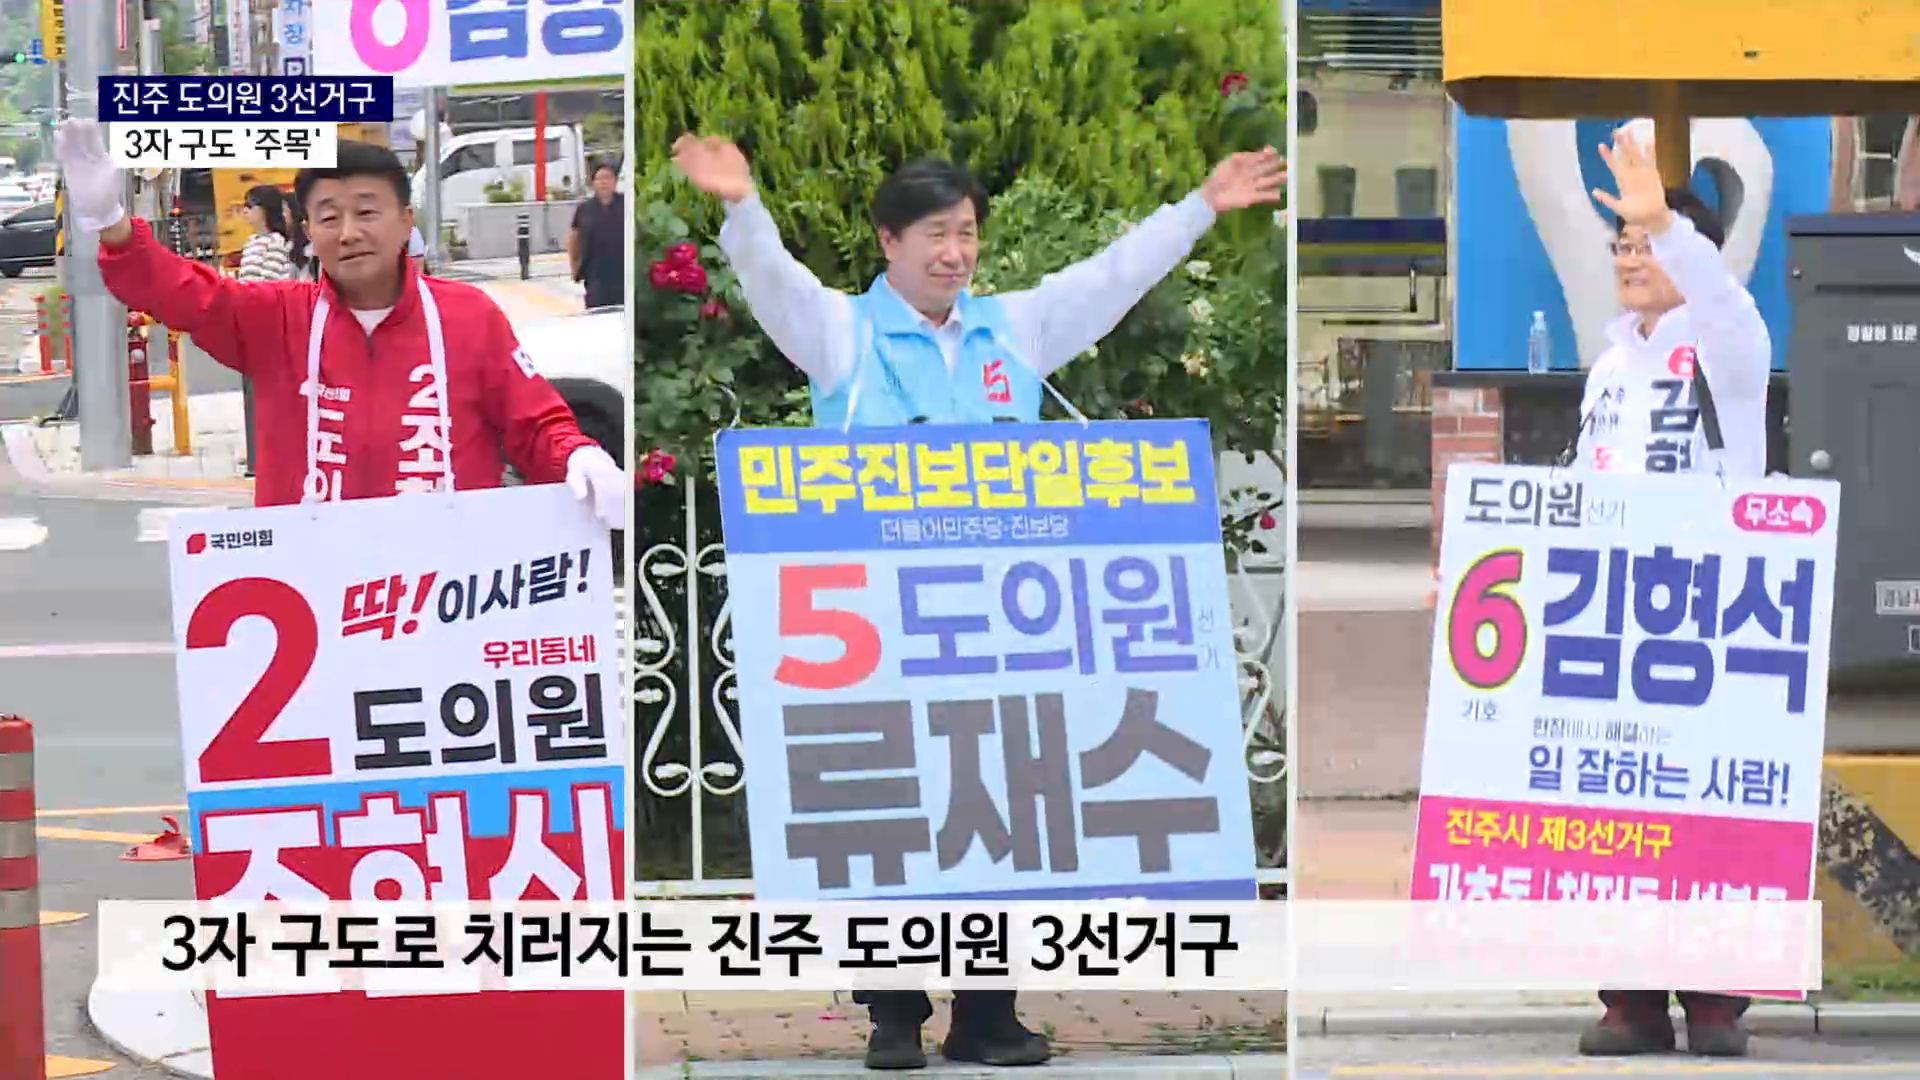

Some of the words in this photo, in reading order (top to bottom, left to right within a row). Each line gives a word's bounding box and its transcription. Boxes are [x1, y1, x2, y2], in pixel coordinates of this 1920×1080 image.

[738, 439, 1195, 515] 민주진보단일후보
[1464, 477, 1583, 528] 도의원
[210, 529, 273, 550] 국민의힘
[341, 571, 439, 641] 딱!
[437, 548, 591, 624] 이사람!
[774, 564, 882, 690] 5
[897, 555, 1198, 676] 도의원
[1448, 545, 1528, 690] 6
[1542, 545, 1815, 715] 김형석
[186, 576, 333, 783] 2
[483, 635, 596, 669] 우리동네
[354, 673, 608, 770] 도의원
[782, 687, 1221, 889] 류재수
[1529, 745, 1563, 792] 일
[1577, 748, 1690, 800] 잘하는
[1701, 756, 1791, 806] 사람!
[1446, 807, 1529, 849] 진주시
[1538, 815, 1673, 860] 제3선거구
